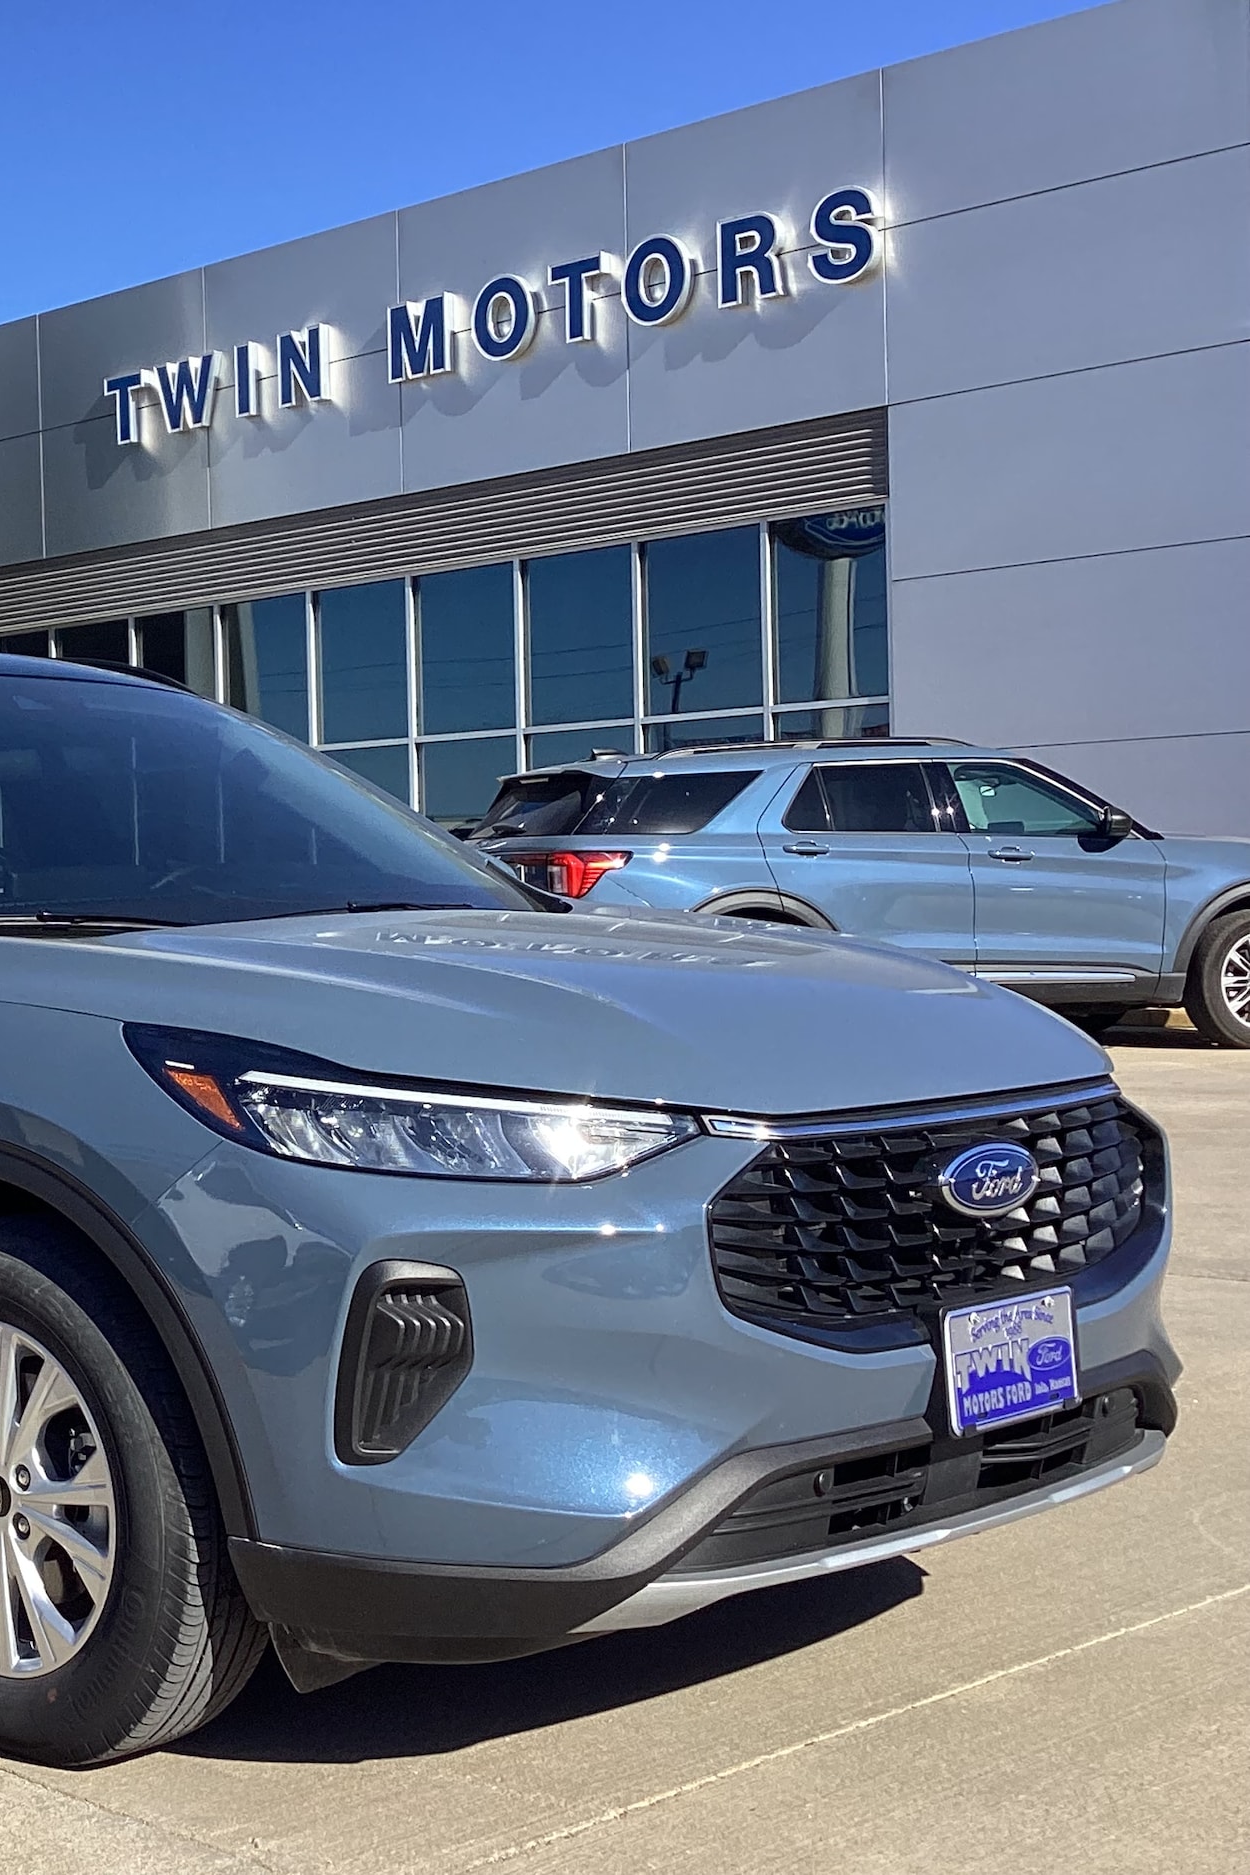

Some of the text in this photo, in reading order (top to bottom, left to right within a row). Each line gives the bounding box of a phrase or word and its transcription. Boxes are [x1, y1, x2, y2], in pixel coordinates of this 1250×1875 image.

[104, 185, 880, 445] TWIN MOTORS
[972, 1159, 1023, 1200] Ford
[955, 1338, 1032, 1394] TWIN
[1036, 1342, 1063, 1366] Ford
[963, 1381, 1032, 1417] MOTORS FORD
